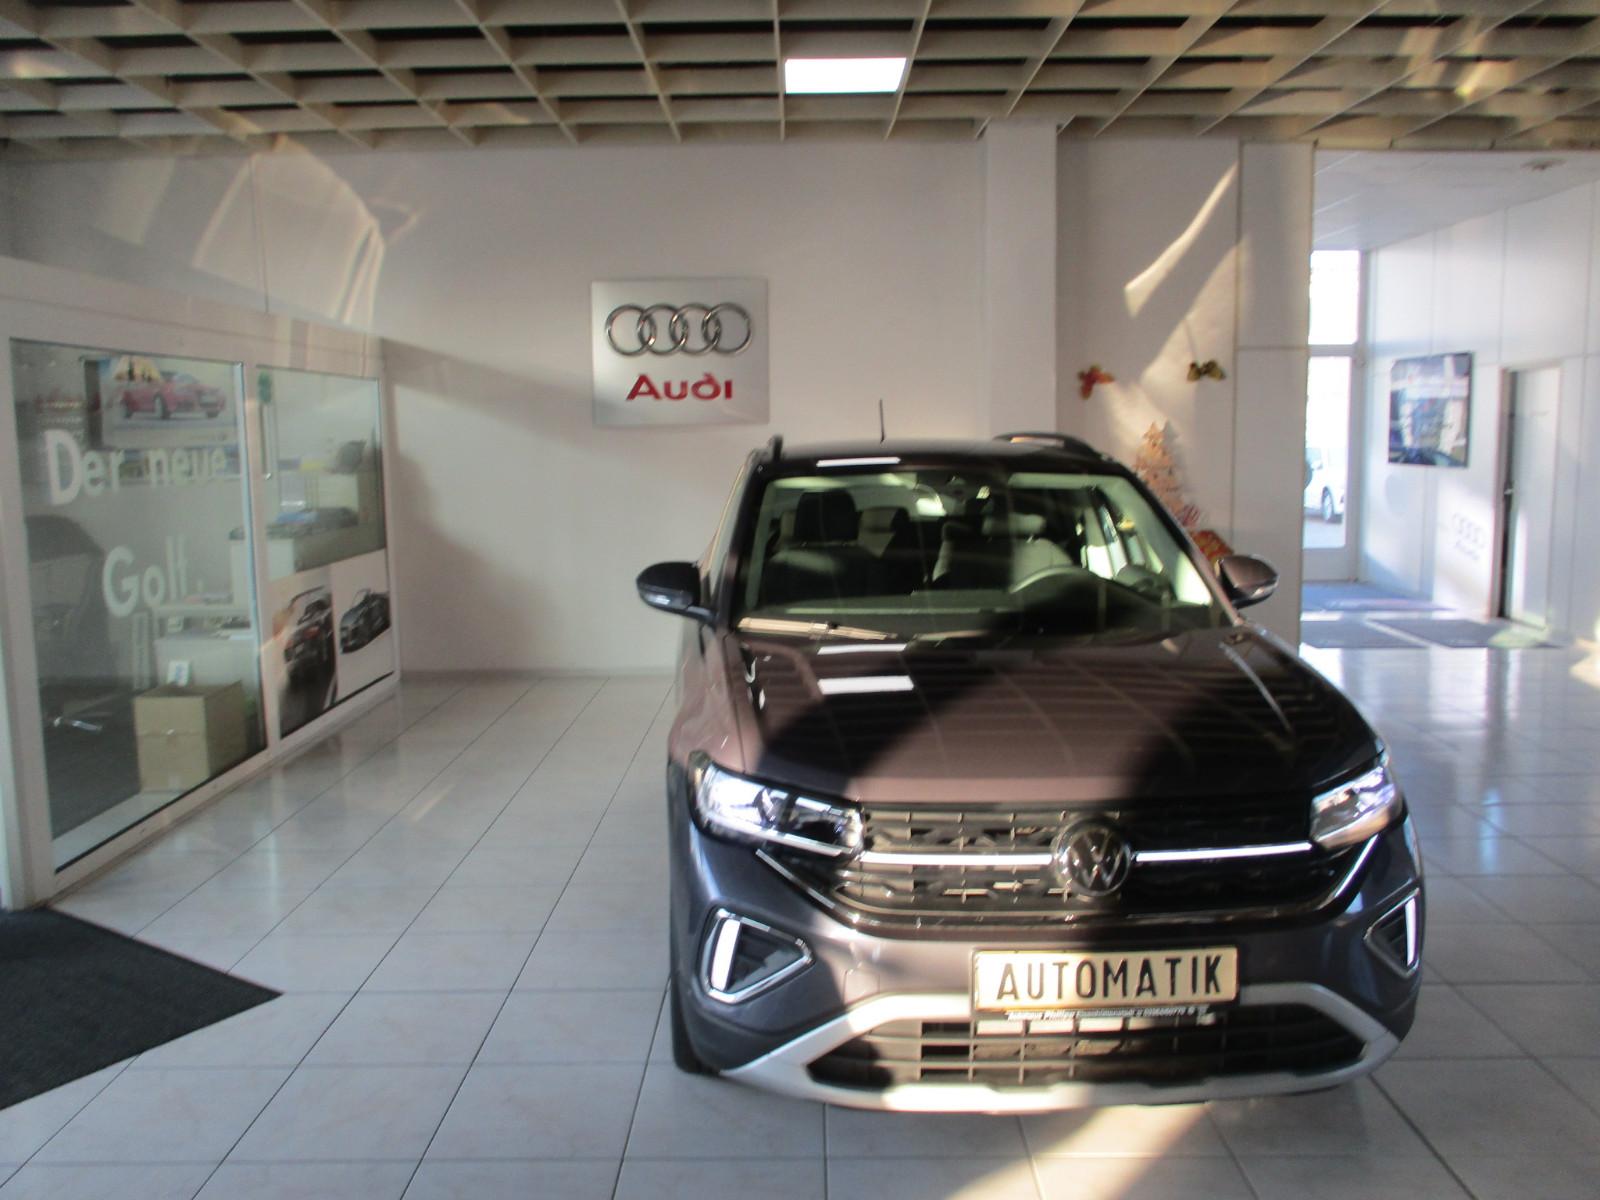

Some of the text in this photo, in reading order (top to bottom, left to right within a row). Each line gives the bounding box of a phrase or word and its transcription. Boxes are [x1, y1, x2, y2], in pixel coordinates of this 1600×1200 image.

[626, 372, 733, 401] Audi
[44, 428, 227, 506] Der neue
[996, 955, 1222, 1001] AUTOMATIK
